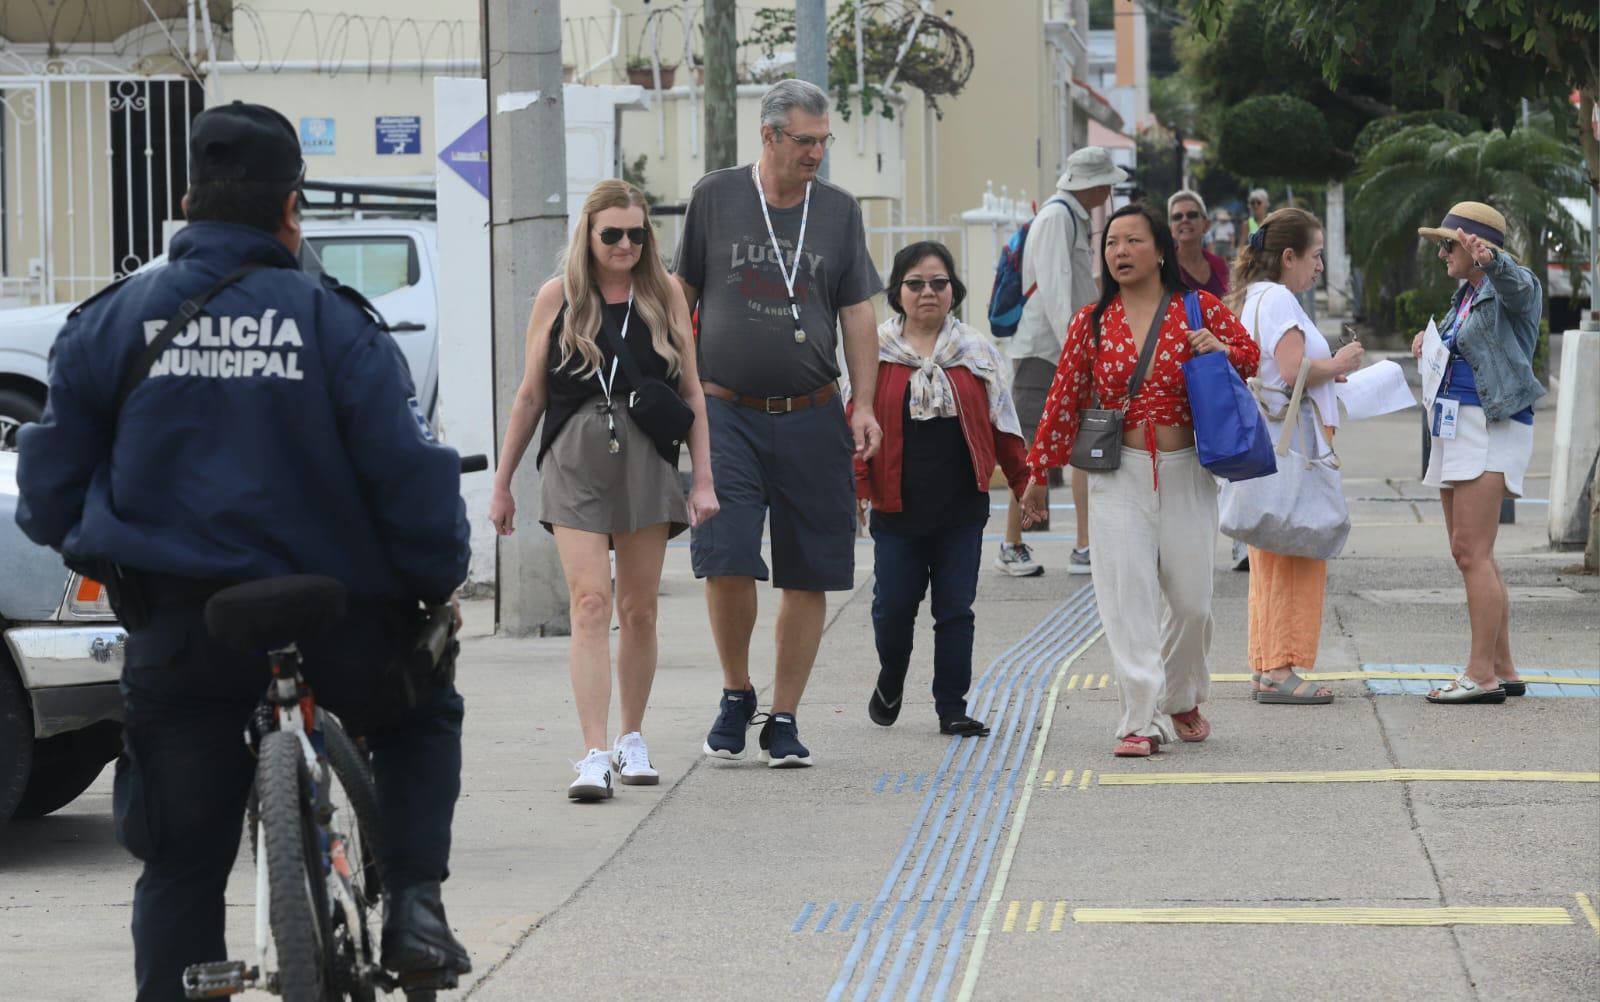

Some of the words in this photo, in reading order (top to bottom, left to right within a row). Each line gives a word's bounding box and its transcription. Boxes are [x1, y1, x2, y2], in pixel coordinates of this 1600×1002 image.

[730, 242, 824, 278] LUCKY
[747, 300, 762, 312] LOS
[764, 304, 802, 316] ANGELS
[143, 308, 304, 347] POLICÍA
[149, 348, 304, 380] MUNICIPAL
